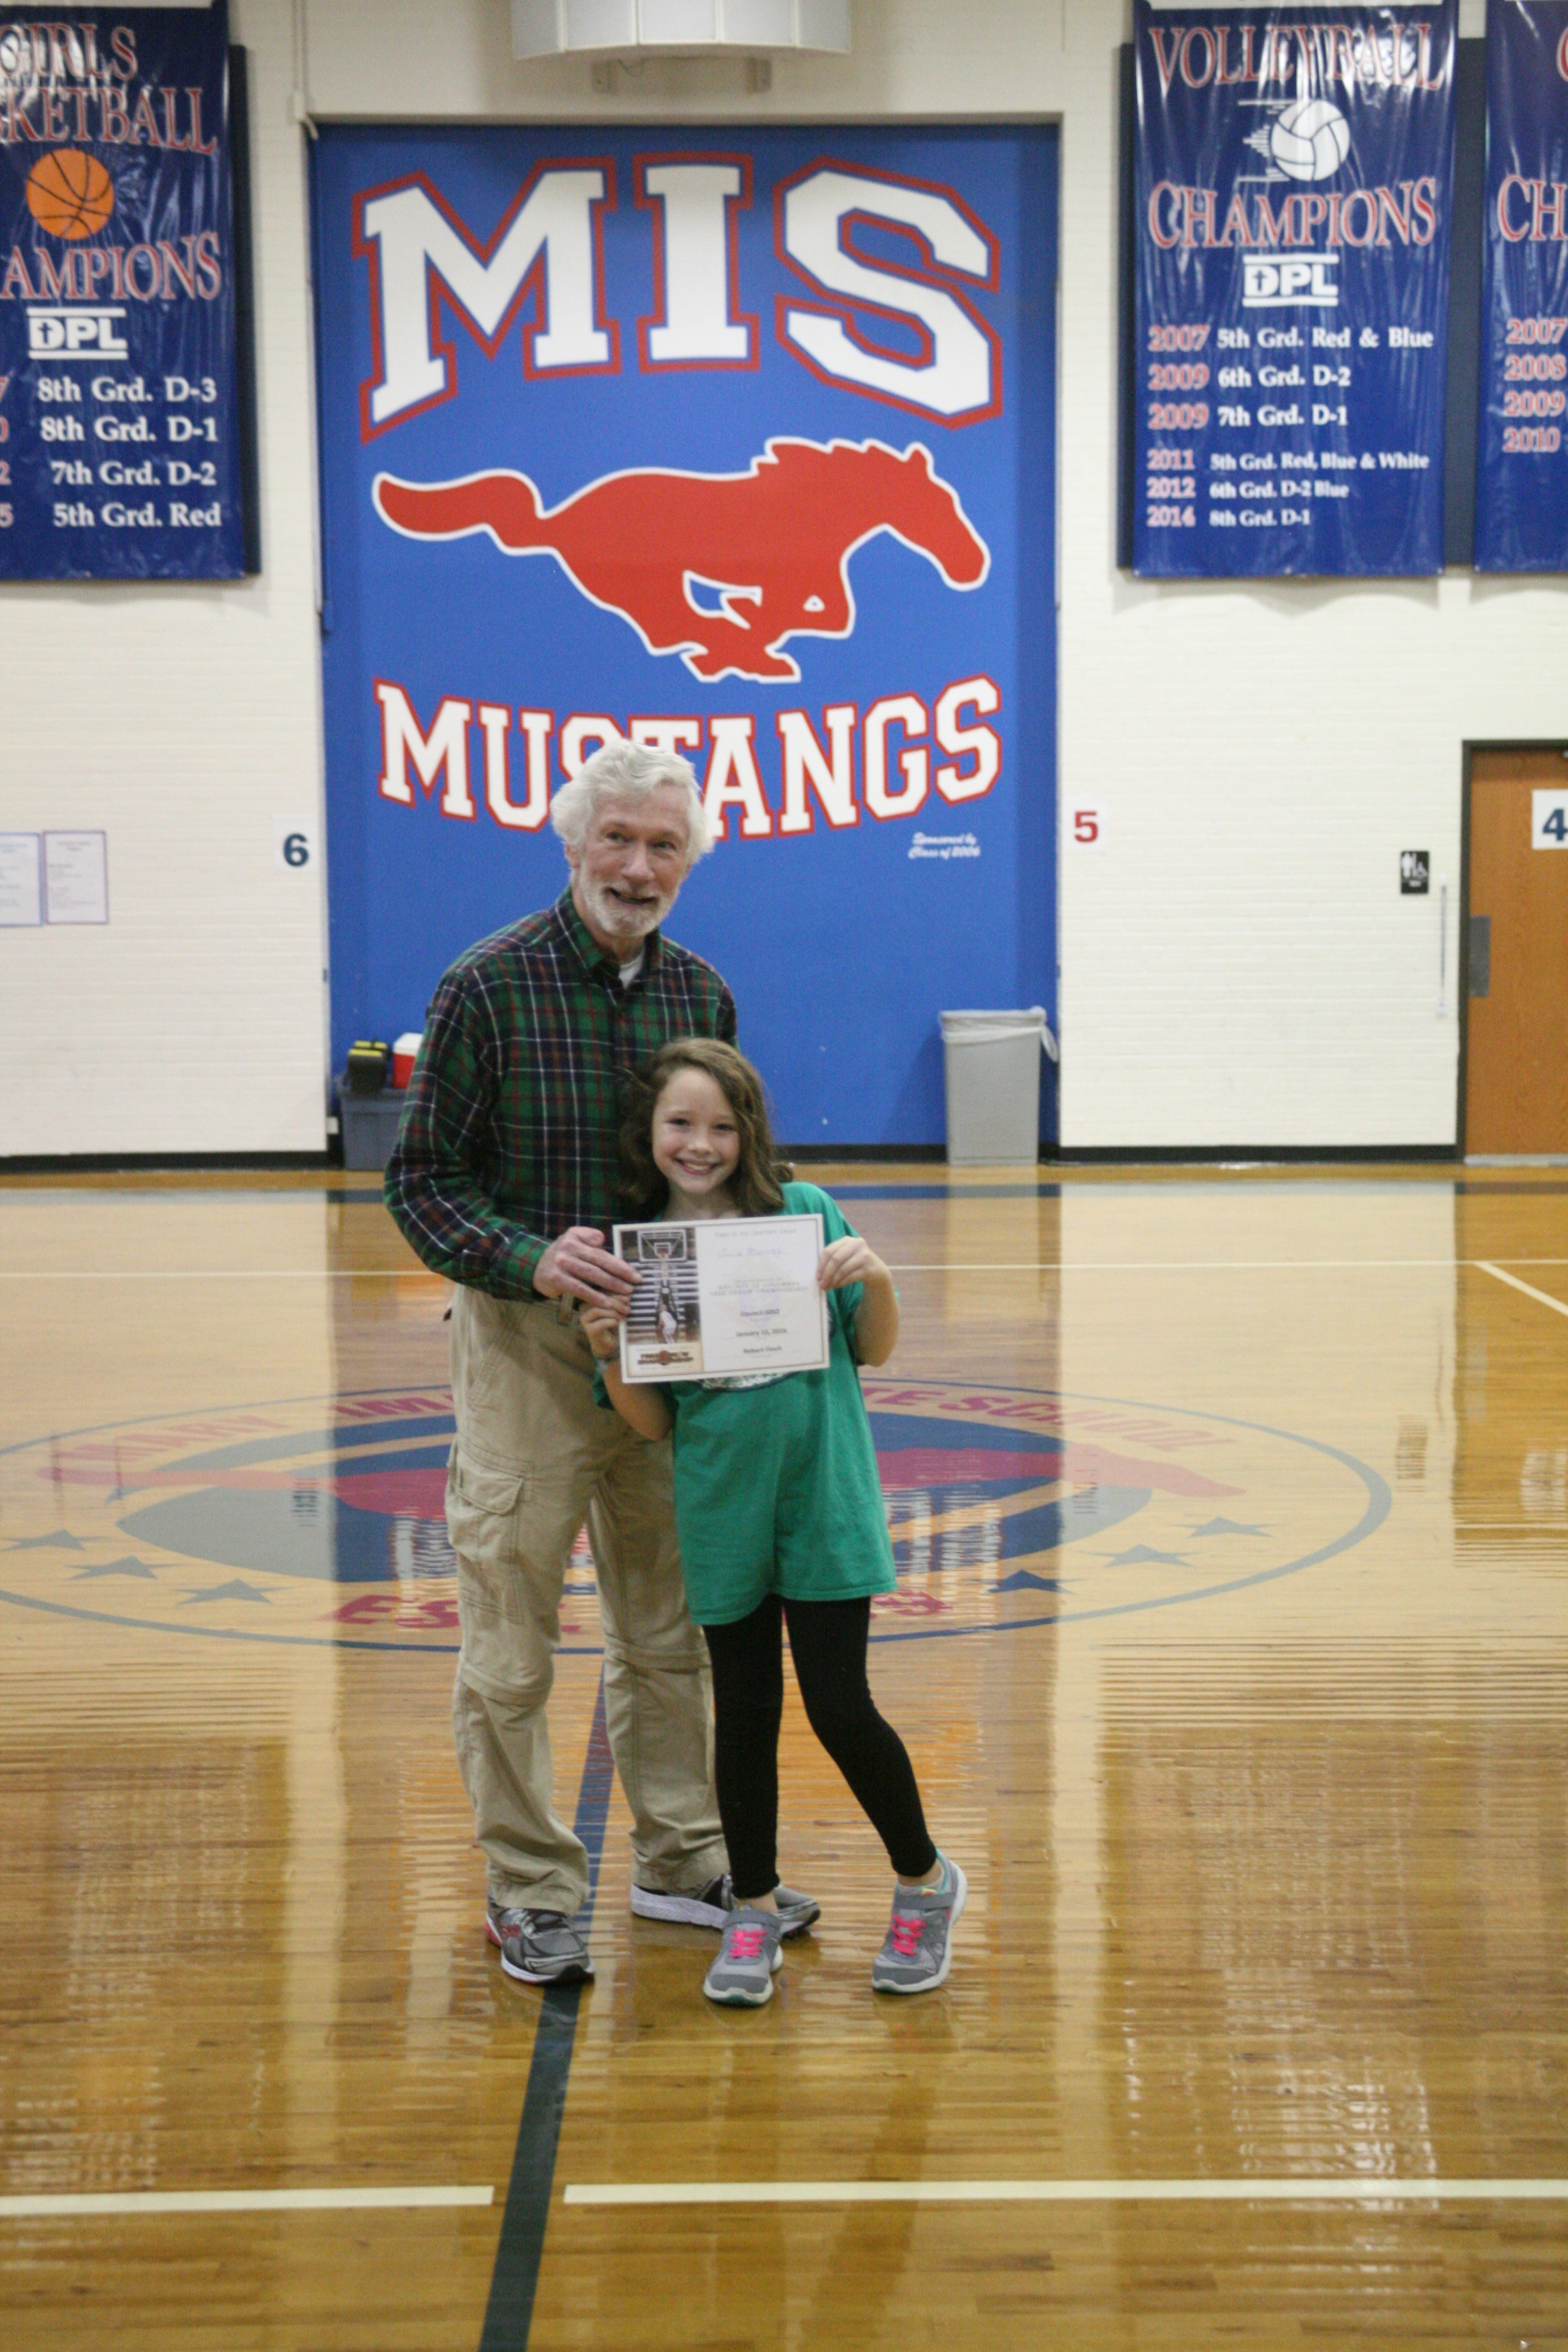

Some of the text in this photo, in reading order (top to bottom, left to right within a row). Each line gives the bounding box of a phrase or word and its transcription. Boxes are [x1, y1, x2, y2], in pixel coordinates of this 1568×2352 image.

[1149, 24, 1445, 90] VOLLEYBALL
[0, 87, 217, 155] KETBALL
[1148, 176, 1436, 249] CHAMPIONS
[1497, 175, 1568, 242] CH
[0, 230, 221, 301] AMPIONS
[1243, 264, 1338, 297] DPL
[351, 152, 1003, 445] MIS
[28, 317, 128, 350] DPL
[1148, 325, 1434, 351] 2007 5th Grd. Red & Blue
[1505, 318, 1568, 345] 2007
[1148, 364, 1351, 391] 2009 6th Grd. D-2
[1504, 352, 1567, 381] 2008
[38, 376, 82, 403] 8th
[91, 376, 153, 403] Grd.
[164, 376, 217, 403] D-3
[1148, 403, 1348, 430] 2009 7th Grd. D-1
[1503, 390, 1566, 417] 2009
[41, 415, 218, 442] 8th Grd. D-1
[1502, 426, 1561, 453] 2010
[51, 461, 217, 485] 7th Grd. D-2
[1147, 449, 1195, 470] 2011
[1239, 453, 1278, 470] Grd.
[1281, 451, 1318, 470] Red,
[1321, 452, 1357, 470] Blue
[1360, 452, 1376, 469] &
[1379, 452, 1429, 469] White
[1147, 477, 1196, 498] 2012
[1239, 481, 1278, 498] Grd.
[1281, 479, 1312, 497] D-2
[1314, 480, 1350, 498] Blue
[53, 502, 222, 527] 5th Grd. Red
[1147, 505, 1196, 528] 2014
[1239, 508, 1278, 527] Grd.
[1281, 508, 1311, 526] D-1
[1074, 810, 1099, 843] 5
[1542, 808, 1568, 841] 4
[283, 832, 310, 868] 6
